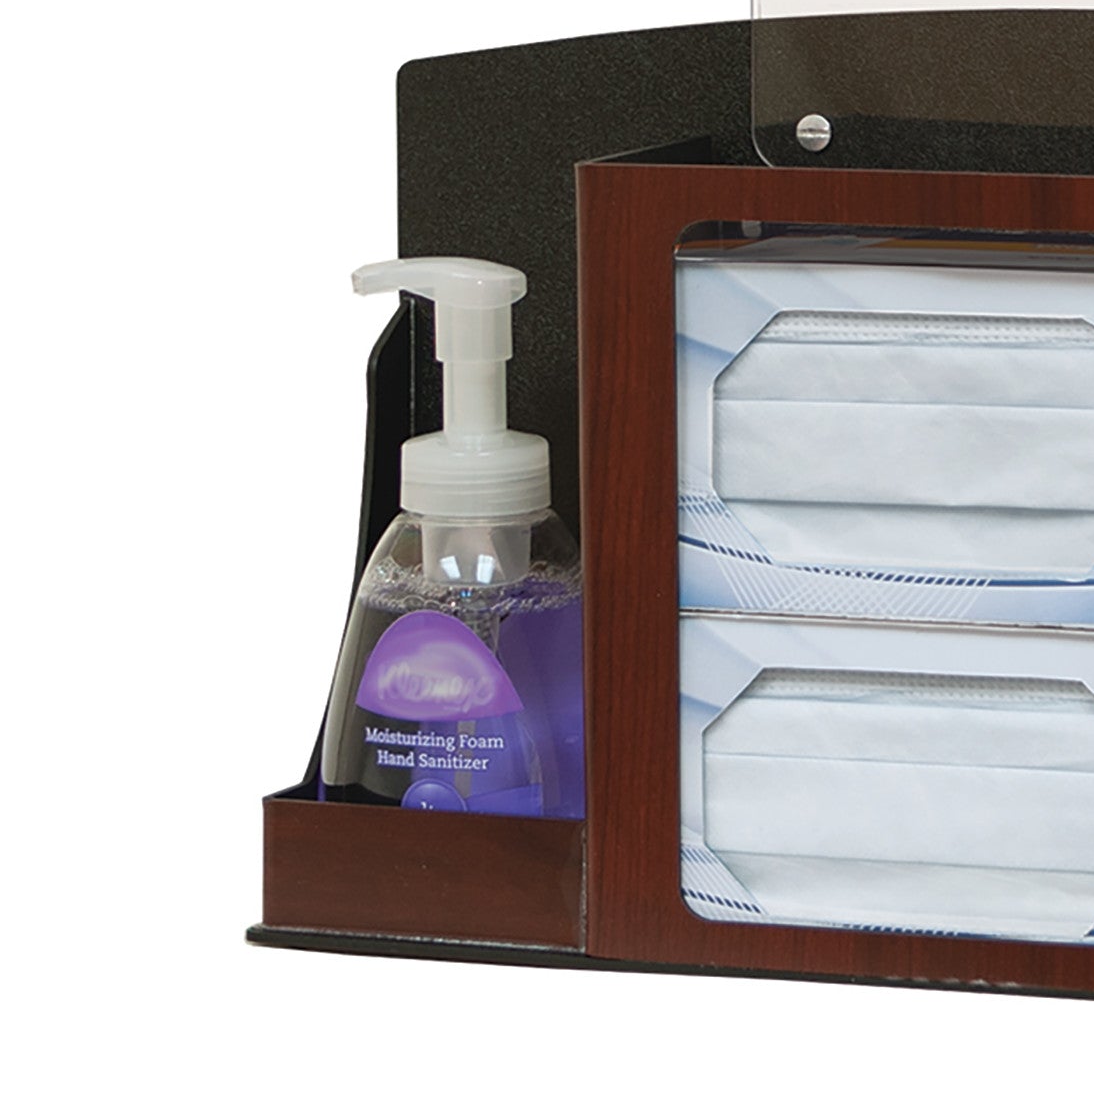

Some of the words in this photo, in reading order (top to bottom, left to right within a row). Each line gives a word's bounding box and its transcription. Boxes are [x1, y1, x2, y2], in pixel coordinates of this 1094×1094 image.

[366, 727, 455, 751] Moisturizing
[459, 733, 504, 750] Foam
[377, 750, 415, 767] Hand
[418, 753, 489, 770] Sanitizer
